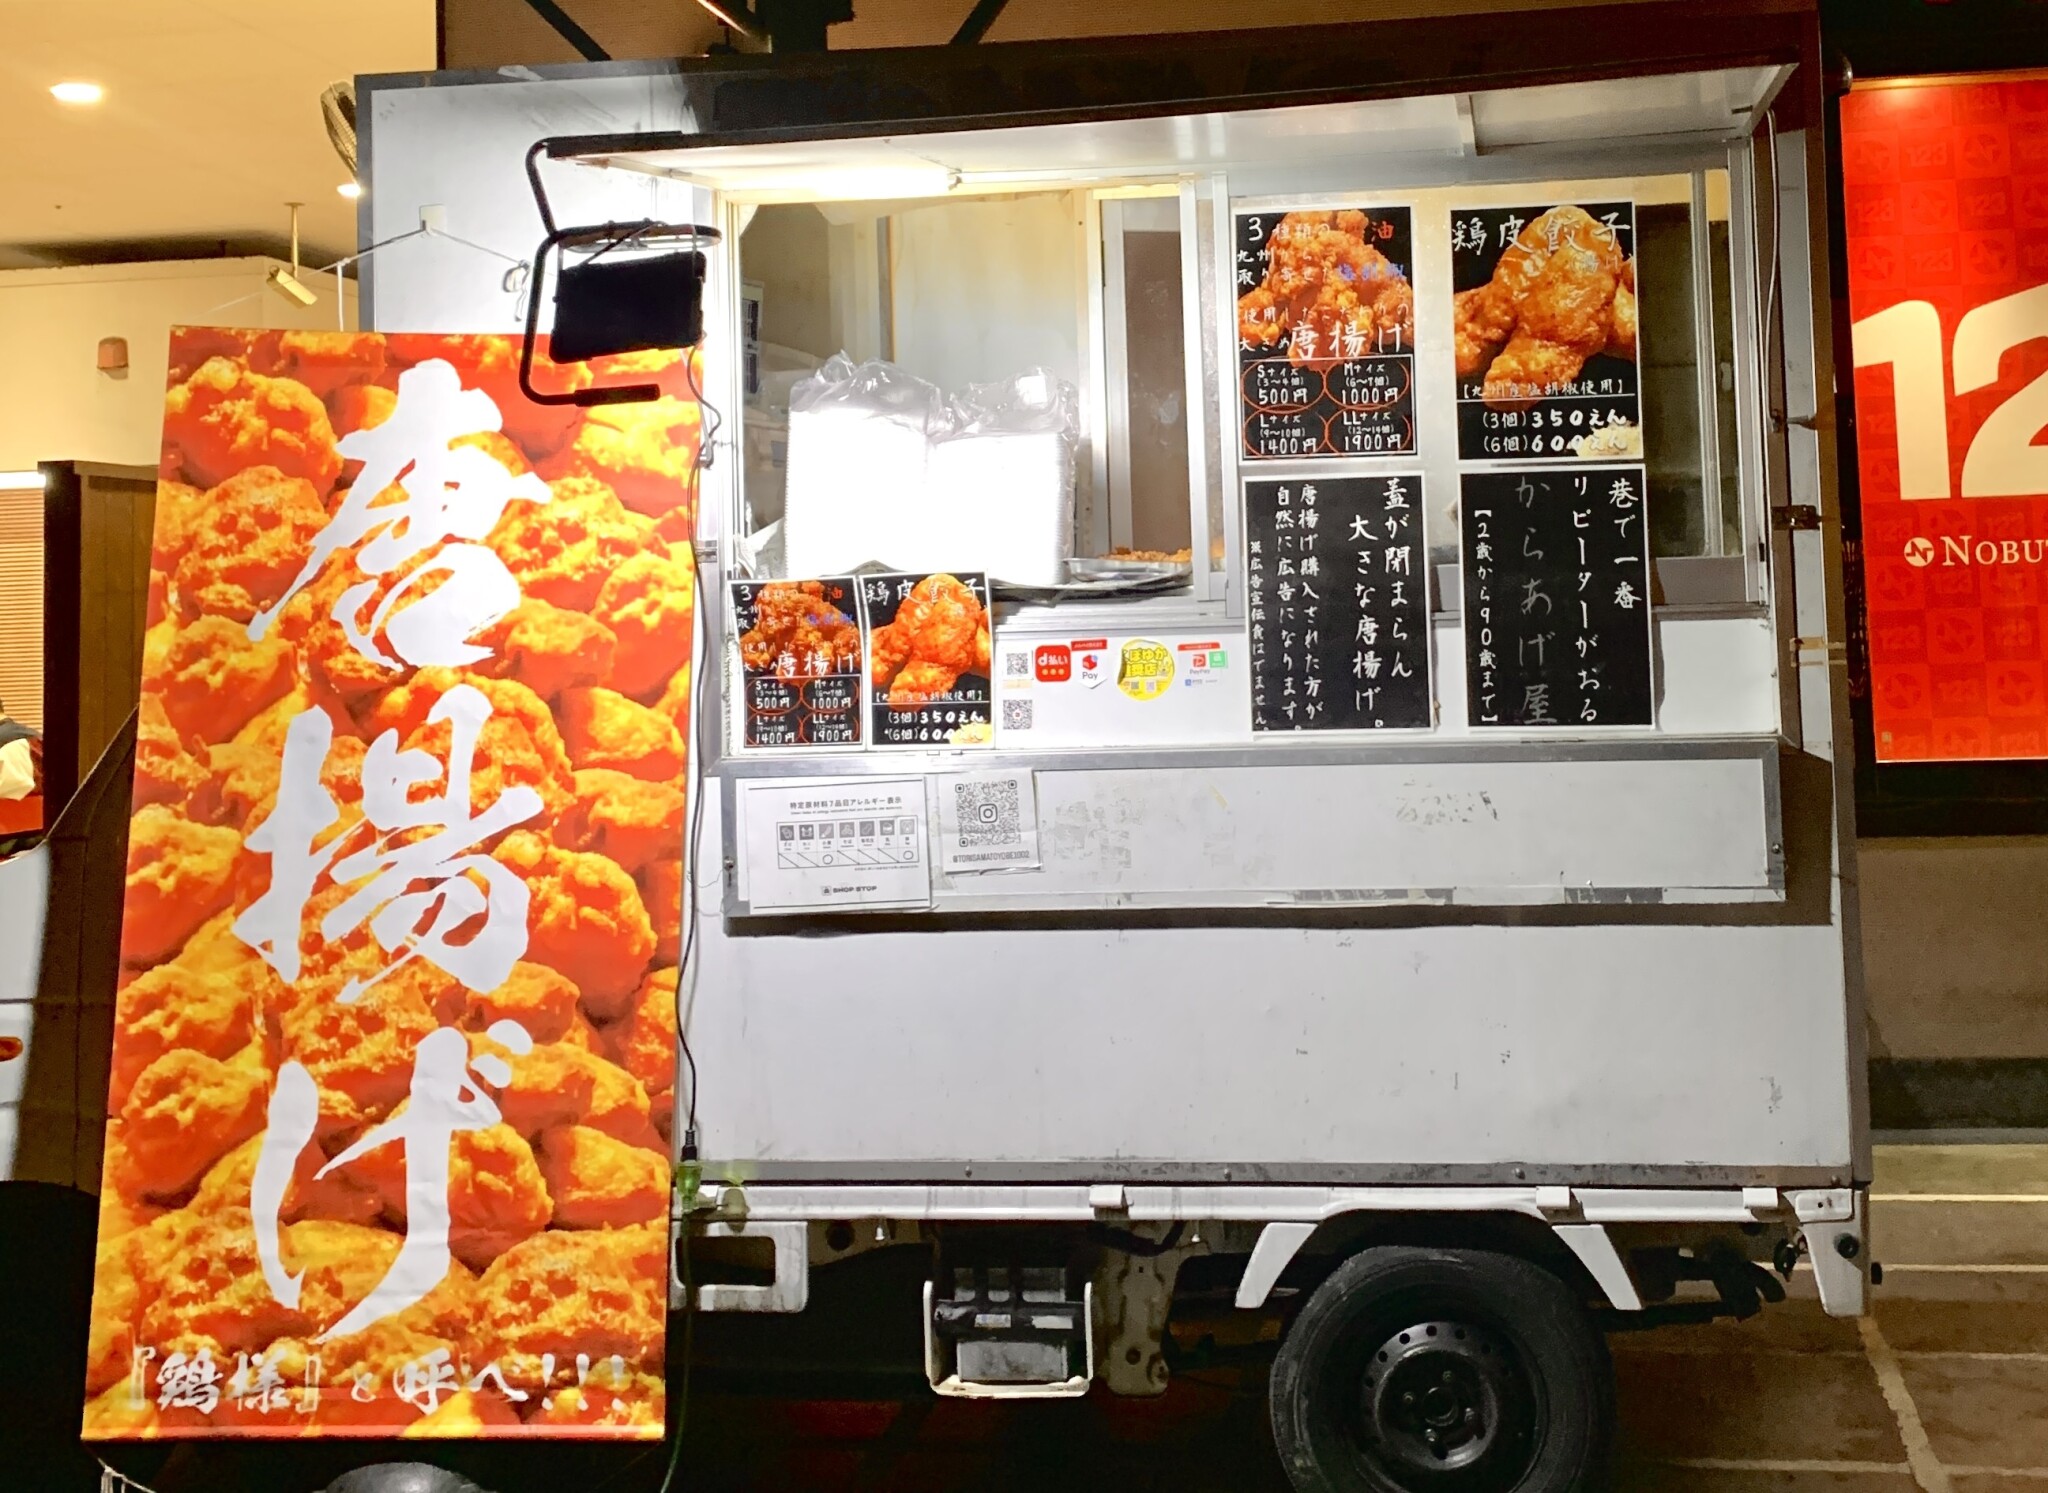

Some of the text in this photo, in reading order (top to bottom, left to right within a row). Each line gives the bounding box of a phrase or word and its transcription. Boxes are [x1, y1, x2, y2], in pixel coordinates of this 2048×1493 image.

[1451, 212, 1631, 256] 鶏皮餃子
[1289, 319, 1412, 360] 唐揚げ
[1257, 364, 1298, 378] Sサイズ
[1343, 362, 1385, 377] Mサイズ
[1258, 388, 1308, 405] 500円
[1342, 387, 1398, 404] 1000円
[1259, 414, 1301, 428] Lサイズ
[1343, 411, 1391, 426] LLサイズ
[1259, 437, 1317, 454] 1400円
[1344, 434, 1401, 451] 1900円
[1608, 476, 1642, 609] 巷で一番
[1940, 535, 2048, 566] NOBU
[1383, 477, 1413, 678] 蓋が閉まらん
[866, 577, 985, 606] 鶏皮餃子
[1514, 475, 1557, 725] からあげ屋
[1572, 476, 1600, 722] リピーターがおる
[1298, 484, 1324, 720] 唐揚げ購入された方が
[776, 649, 860, 678] 唐揚げ
[1081, 671, 1098, 680] Pay
[756, 697, 790, 709] 500円
[813, 697, 851, 709] 1000円
[756, 732, 795, 744] 1400円
[813, 729, 852, 742] 1900円
[232, 356, 551, 1345] 唐揚げ
